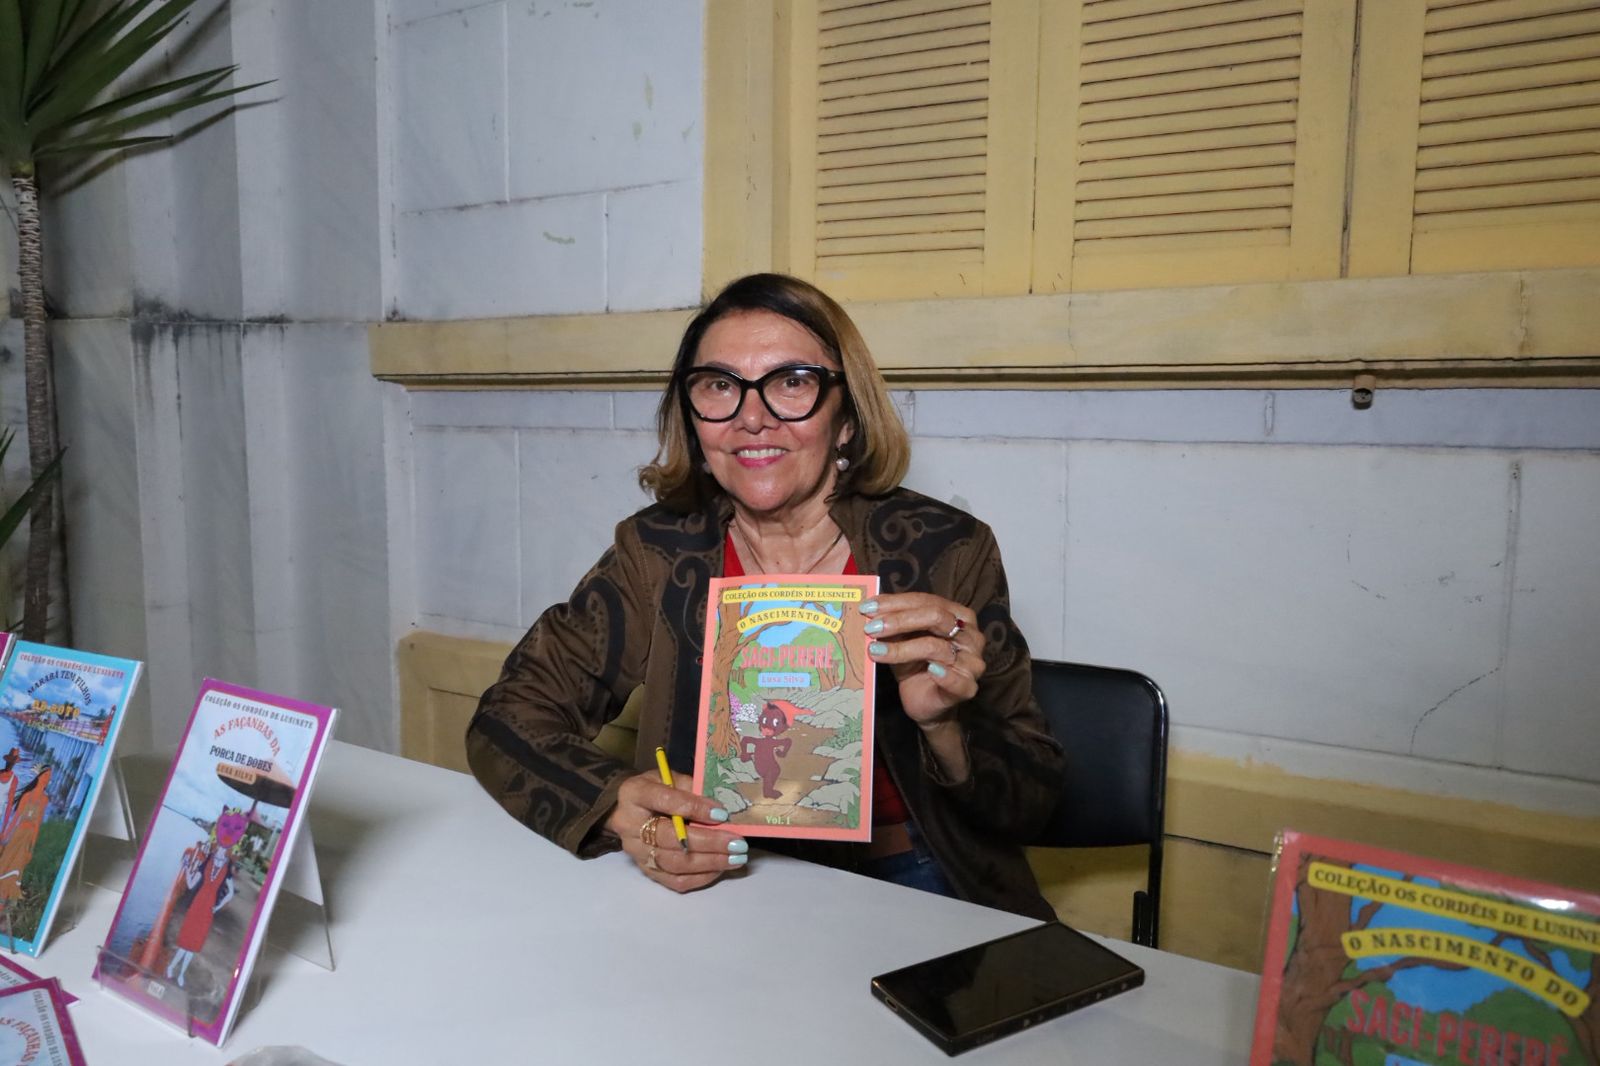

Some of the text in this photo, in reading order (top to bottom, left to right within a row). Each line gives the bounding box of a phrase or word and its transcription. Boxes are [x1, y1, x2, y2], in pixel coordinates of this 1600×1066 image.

[725, 590, 756, 600] COLEÇÃO
[769, 589, 804, 598] CORDÉIS
[817, 590, 857, 599] LUSINETE
[750, 610, 820, 624] NASCIMENTO
[823, 617, 838, 628] DO
[741, 643, 834, 668] SACI-PERERÉ
[61, 670, 76, 681] TEM
[762, 674, 804, 683] Lusa Silva
[205, 694, 232, 708] COLEÇÃO
[233, 702, 241, 711] OS
[242, 704, 269, 718] CORDÉIS
[270, 711, 279, 720] DE
[214, 716, 281, 757] AS FAÇANHAS DA
[209, 744, 273, 773] PORCA DE BOBES
[765, 815, 785, 825] Vol.
[1314, 867, 1390, 897] COLEÇÃO
[1395, 887, 1417, 904] OS
[1421, 892, 1498, 923] CORDÉIS
[1503, 911, 1528, 929] DE
[1349, 933, 1579, 1007] O NASCIMENTO DO
